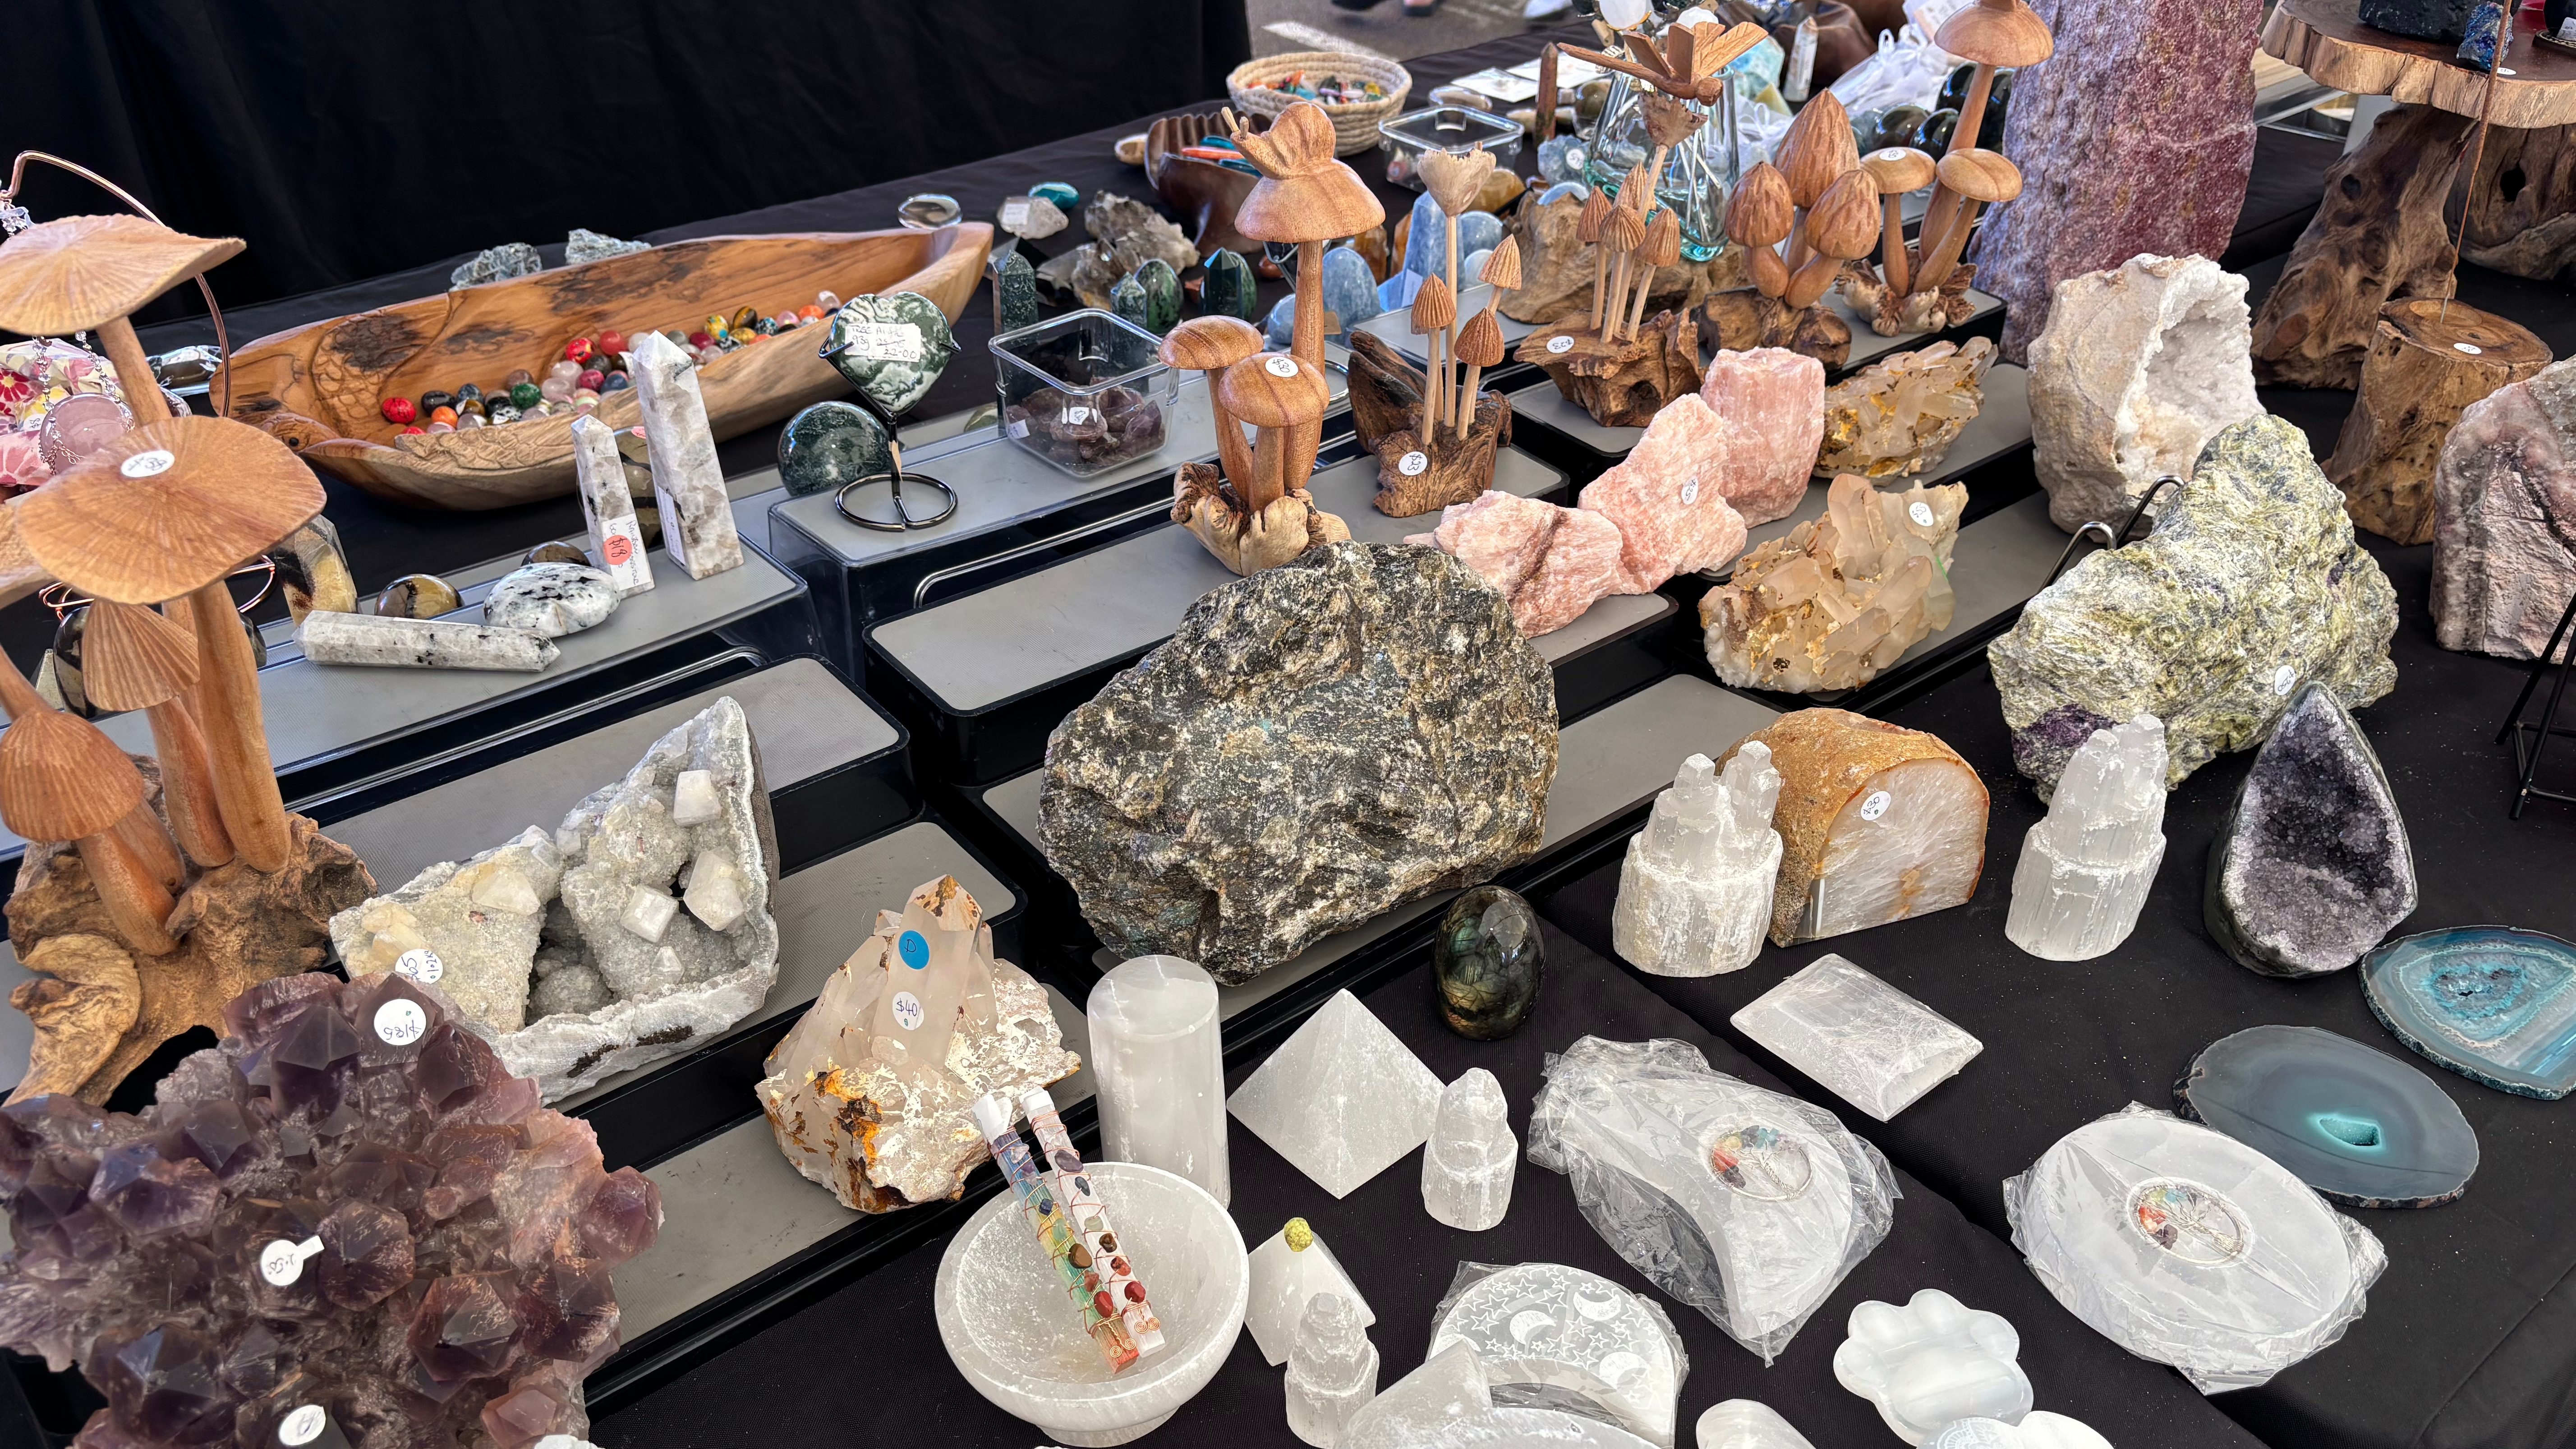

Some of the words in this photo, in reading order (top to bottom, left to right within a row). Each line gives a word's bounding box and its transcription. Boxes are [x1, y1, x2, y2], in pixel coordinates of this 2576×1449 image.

[1272, 359, 1290, 373] $30
[1408, 454, 1423, 470] $23
[608, 538, 628, 557] $18
[1863, 796, 1880, 815] $30
[904, 939, 916, 953] D
[896, 998, 918, 1017] $40
[383, 1020, 422, 1040] $185
